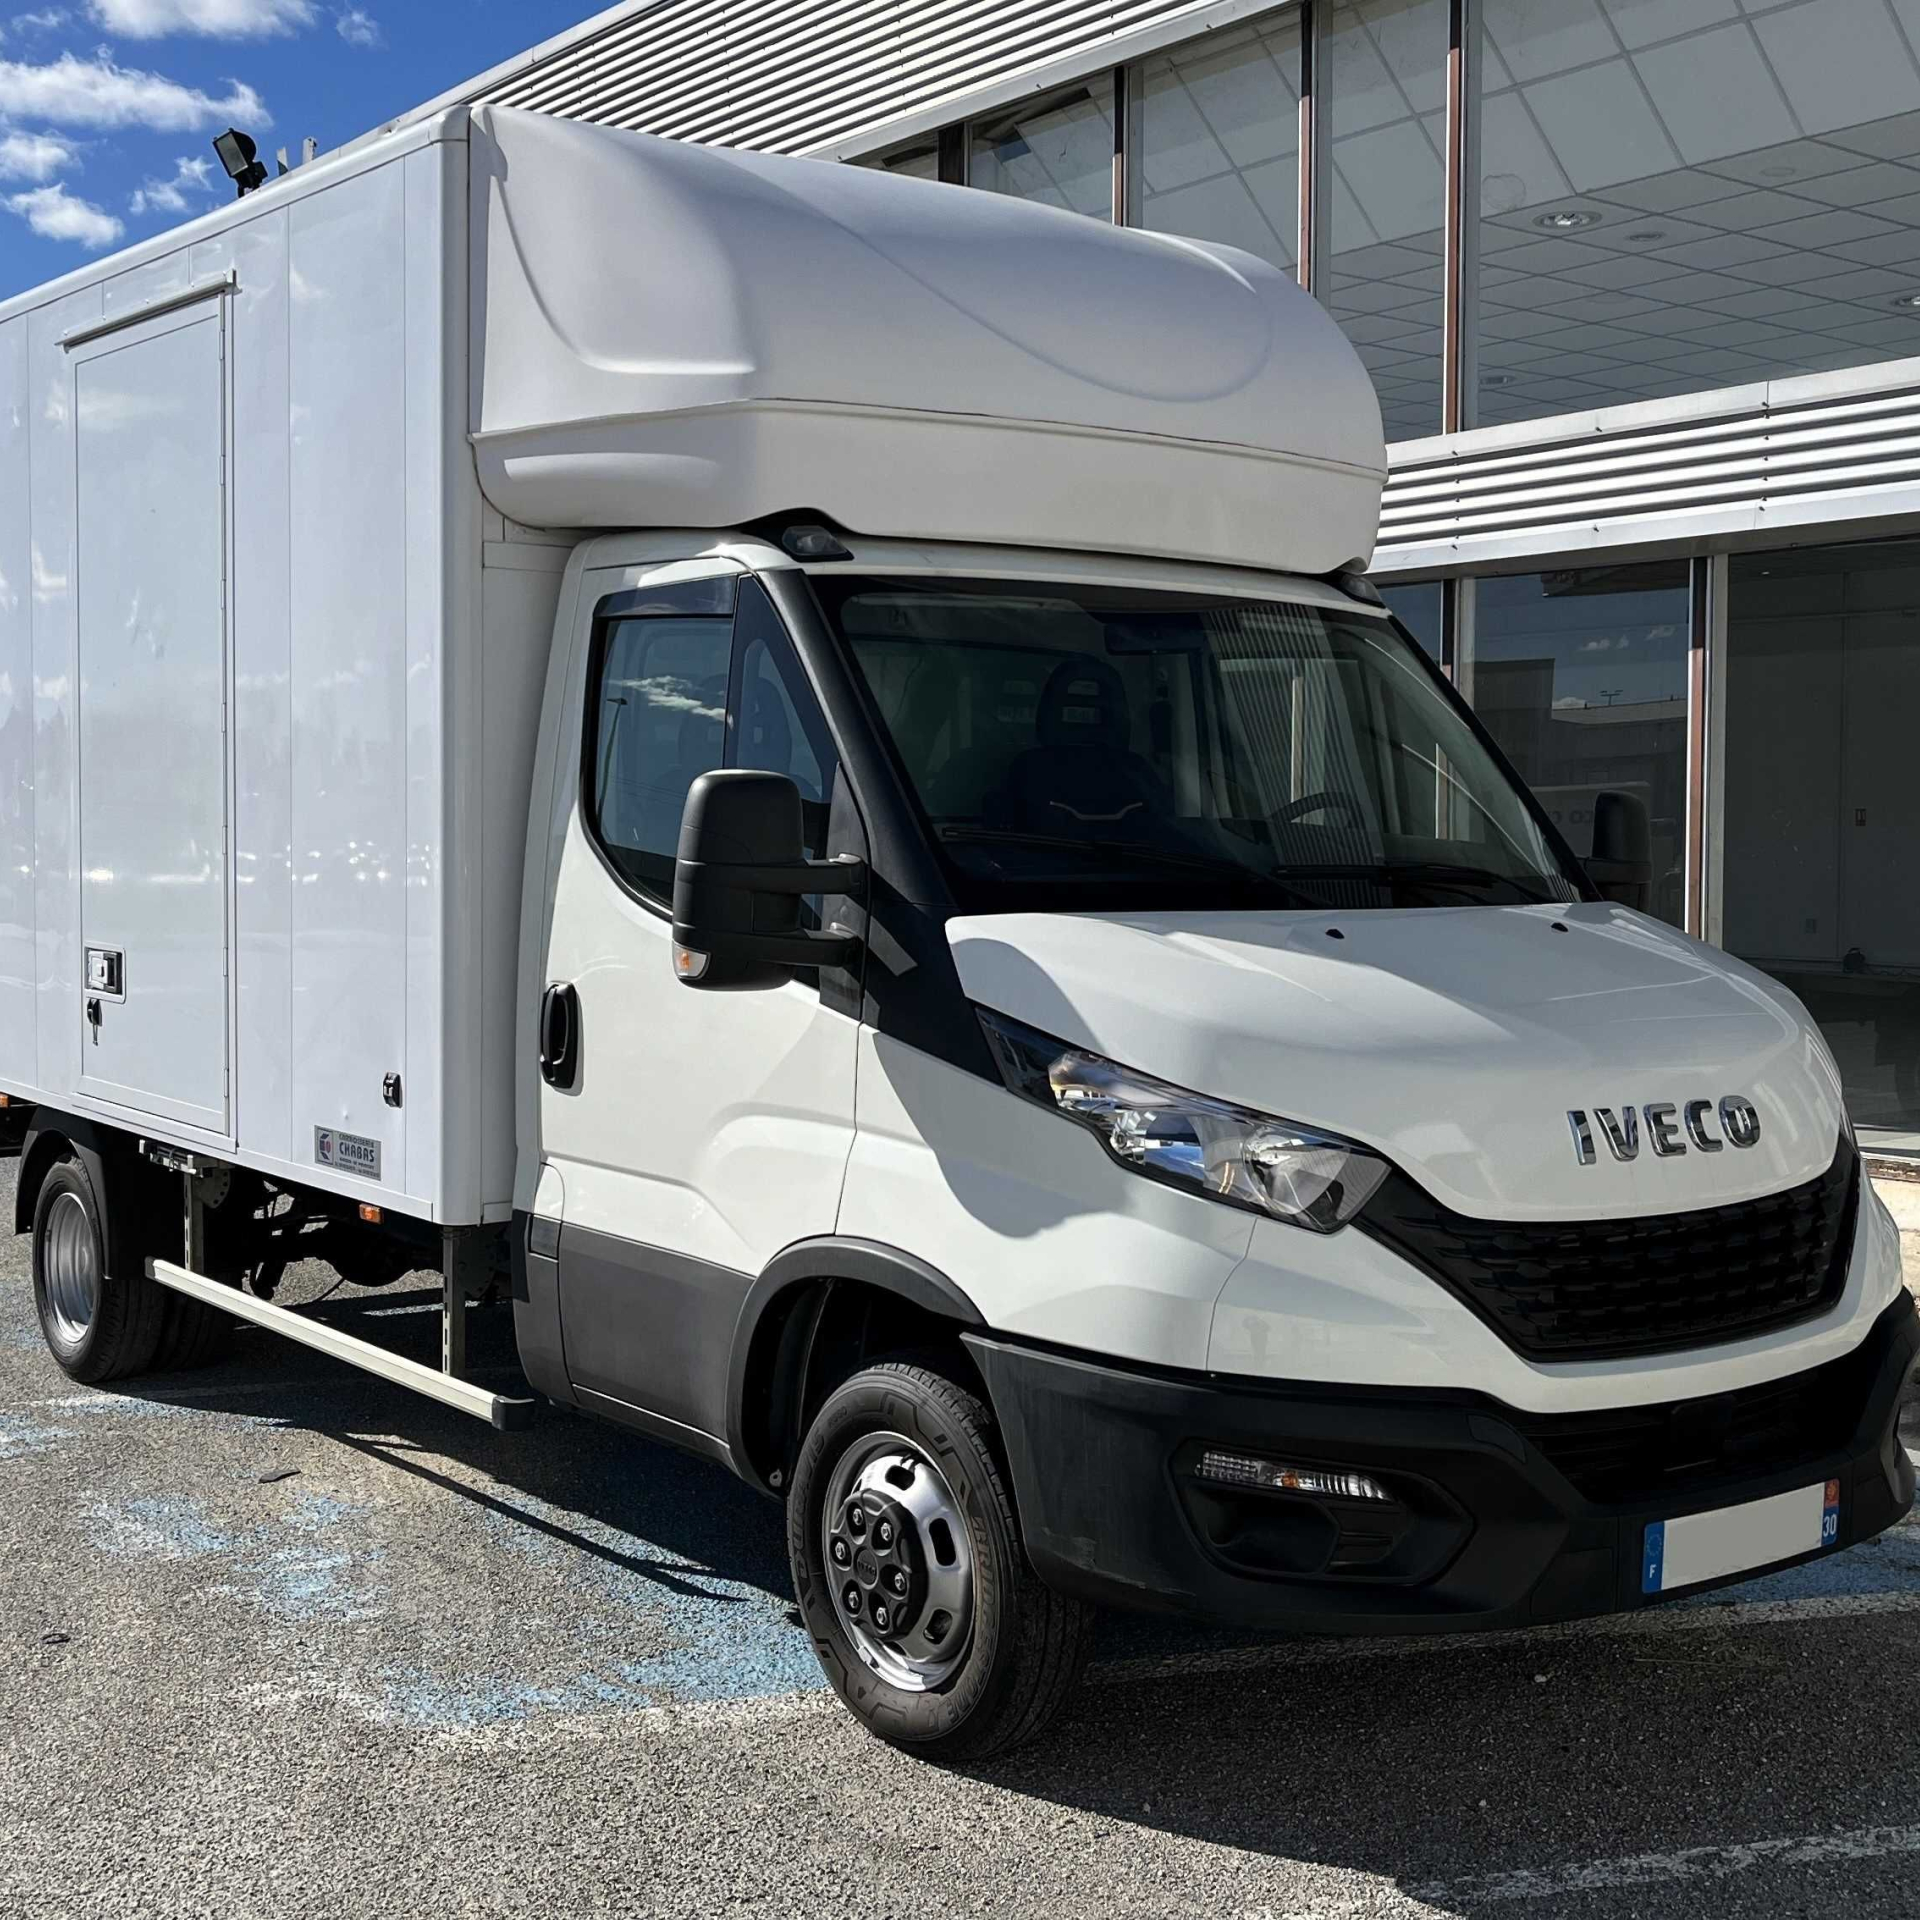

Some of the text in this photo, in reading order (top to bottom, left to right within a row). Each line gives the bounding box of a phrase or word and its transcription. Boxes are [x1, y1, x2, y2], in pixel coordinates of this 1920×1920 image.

[1566, 1095, 1761, 1165] IVECO
[339, 1142, 375, 1162] CHABAS
[1822, 1513, 1838, 1537] 30
[1649, 1564, 1657, 1579] F
